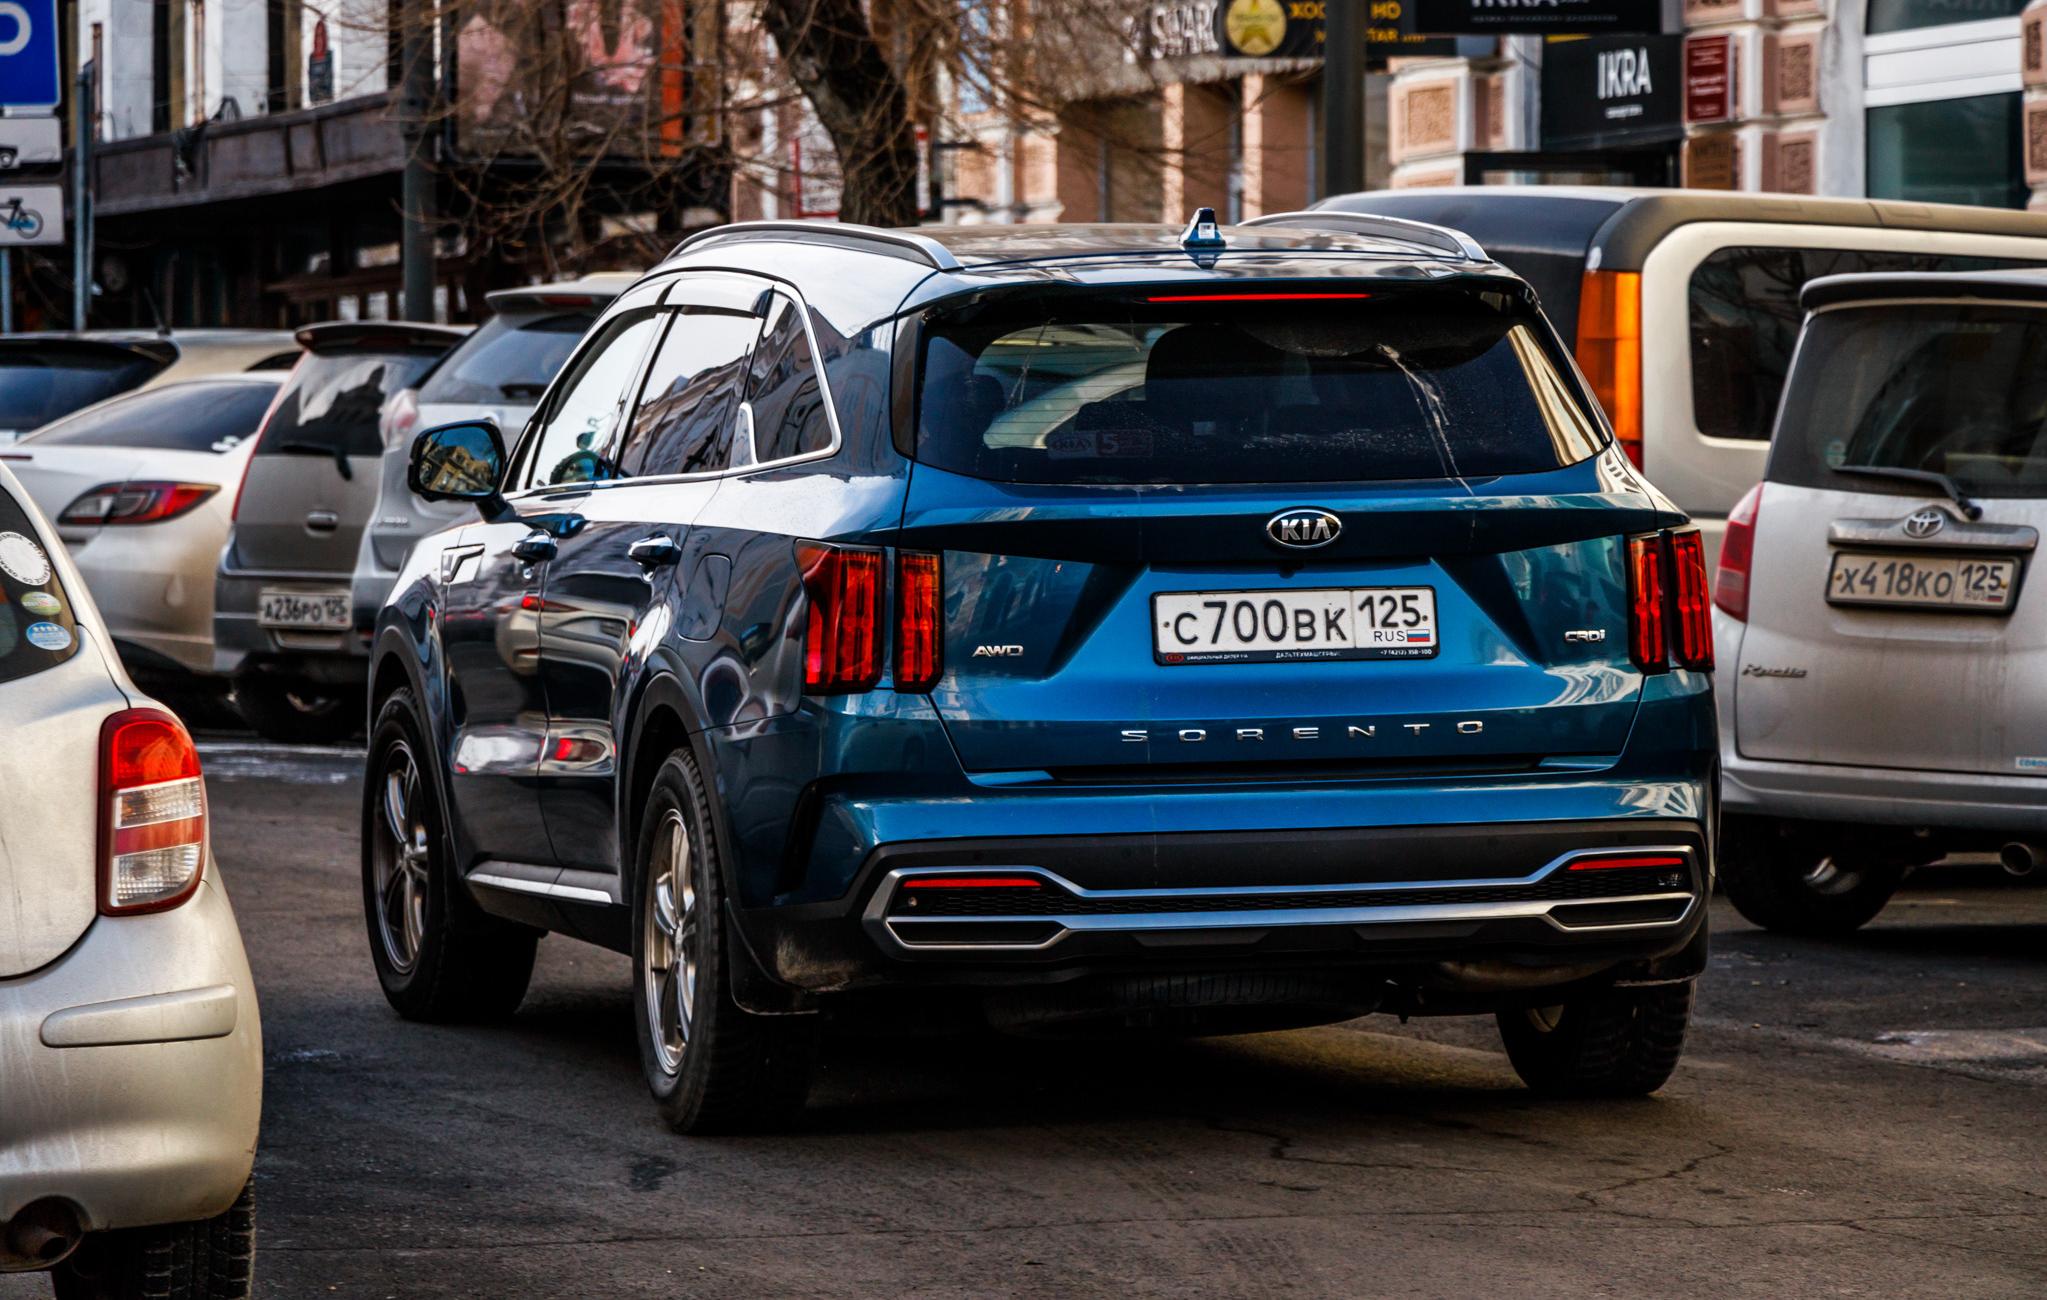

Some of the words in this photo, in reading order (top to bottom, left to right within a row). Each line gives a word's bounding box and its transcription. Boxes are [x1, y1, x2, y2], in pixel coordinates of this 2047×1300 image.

[1597, 46, 1653, 100] IKRA
[1281, 518, 1332, 541] KIA
[1961, 564, 2004, 592] 125
[1357, 594, 1422, 629] 125
[1373, 630, 1406, 643] RUS
[971, 644, 1025, 658] AWD
[1120, 719, 1484, 743] SORENTO
